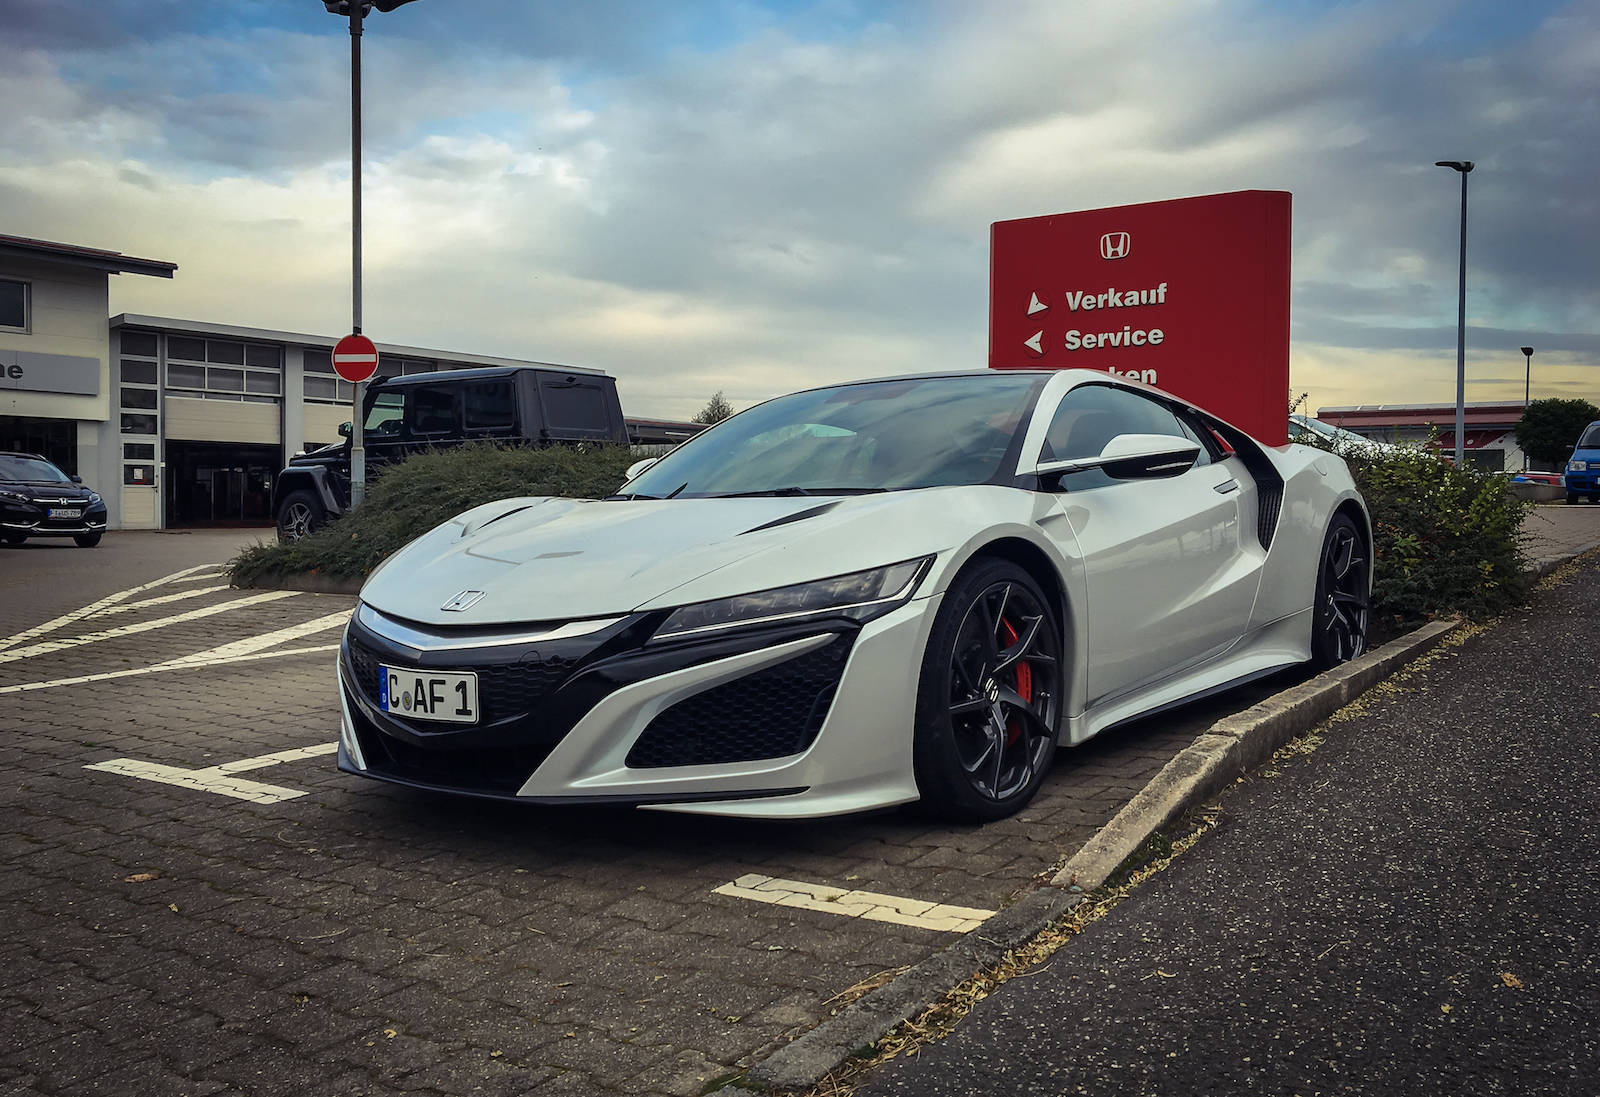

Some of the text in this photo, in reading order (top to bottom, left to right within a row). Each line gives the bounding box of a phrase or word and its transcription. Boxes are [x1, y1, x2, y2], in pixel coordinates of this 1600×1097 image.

[1065, 282, 1168, 311] Verkauf
[1064, 325, 1164, 350] Service
[389, 674, 472, 716] C AF 1
